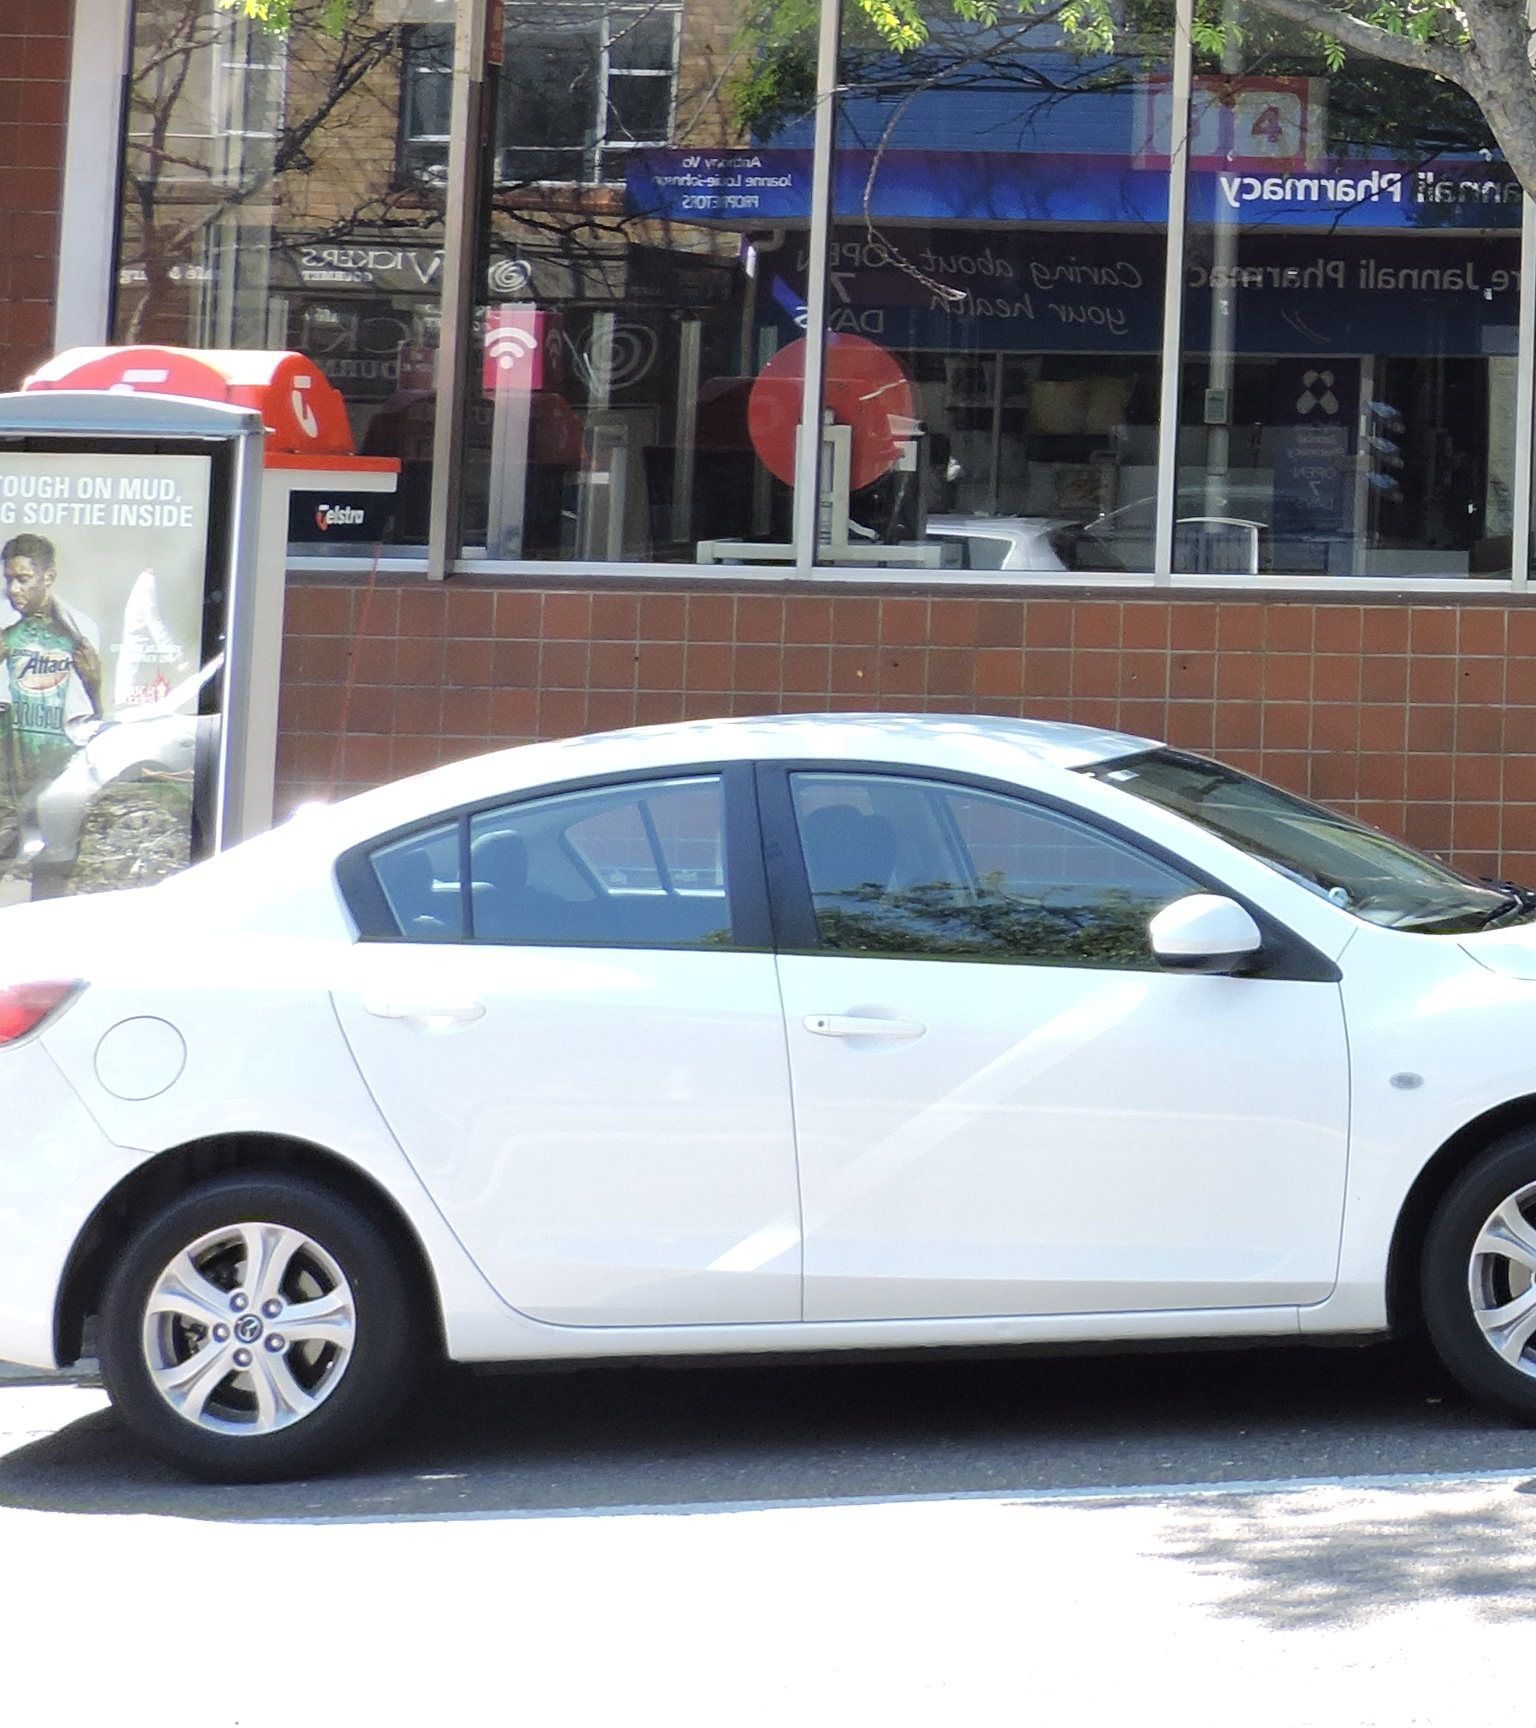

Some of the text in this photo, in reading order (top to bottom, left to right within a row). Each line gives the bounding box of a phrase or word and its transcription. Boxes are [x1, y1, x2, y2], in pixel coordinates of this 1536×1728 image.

[1252, 105, 1283, 143] 4
[76, 477, 111, 500] ON
[23, 502, 106, 526] SOFTIE
[111, 504, 194, 527] INSIDE
